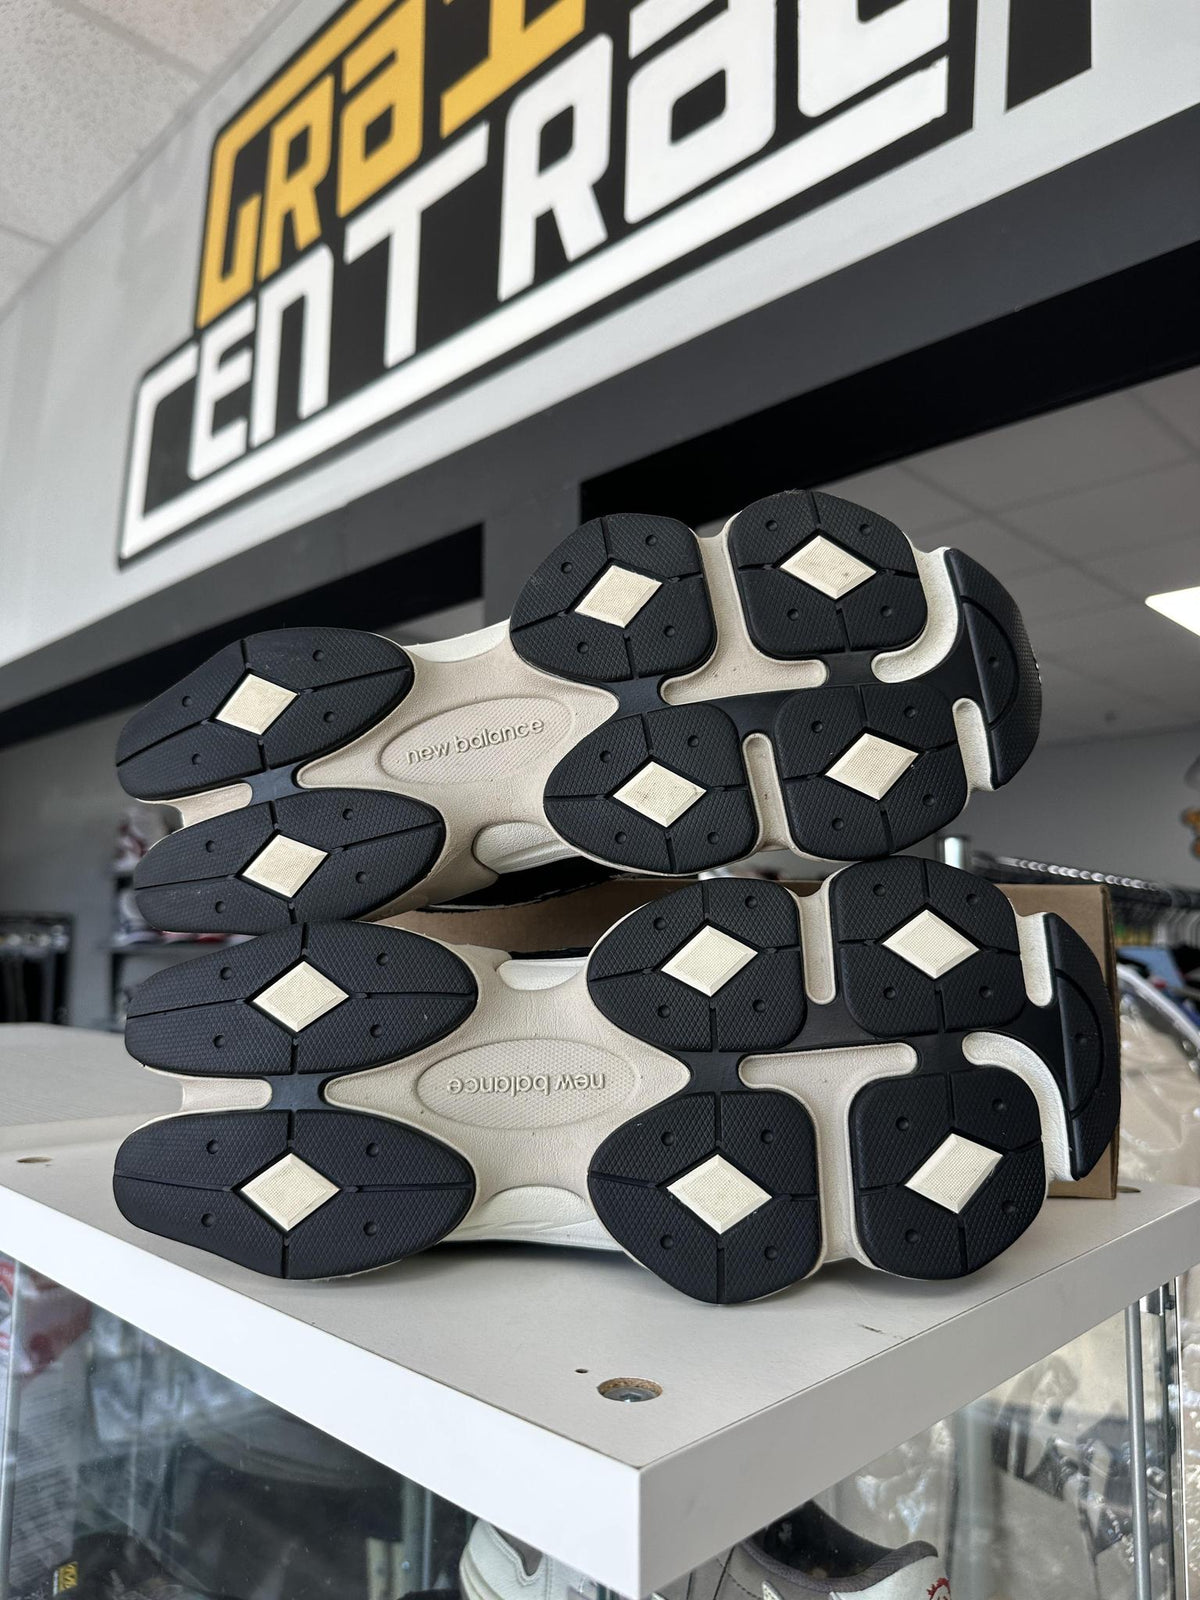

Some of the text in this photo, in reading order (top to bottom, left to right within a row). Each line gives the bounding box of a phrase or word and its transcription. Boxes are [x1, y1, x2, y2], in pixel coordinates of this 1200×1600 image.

[406, 719, 545, 764] new balance
[447, 1073, 605, 1097] new balance
